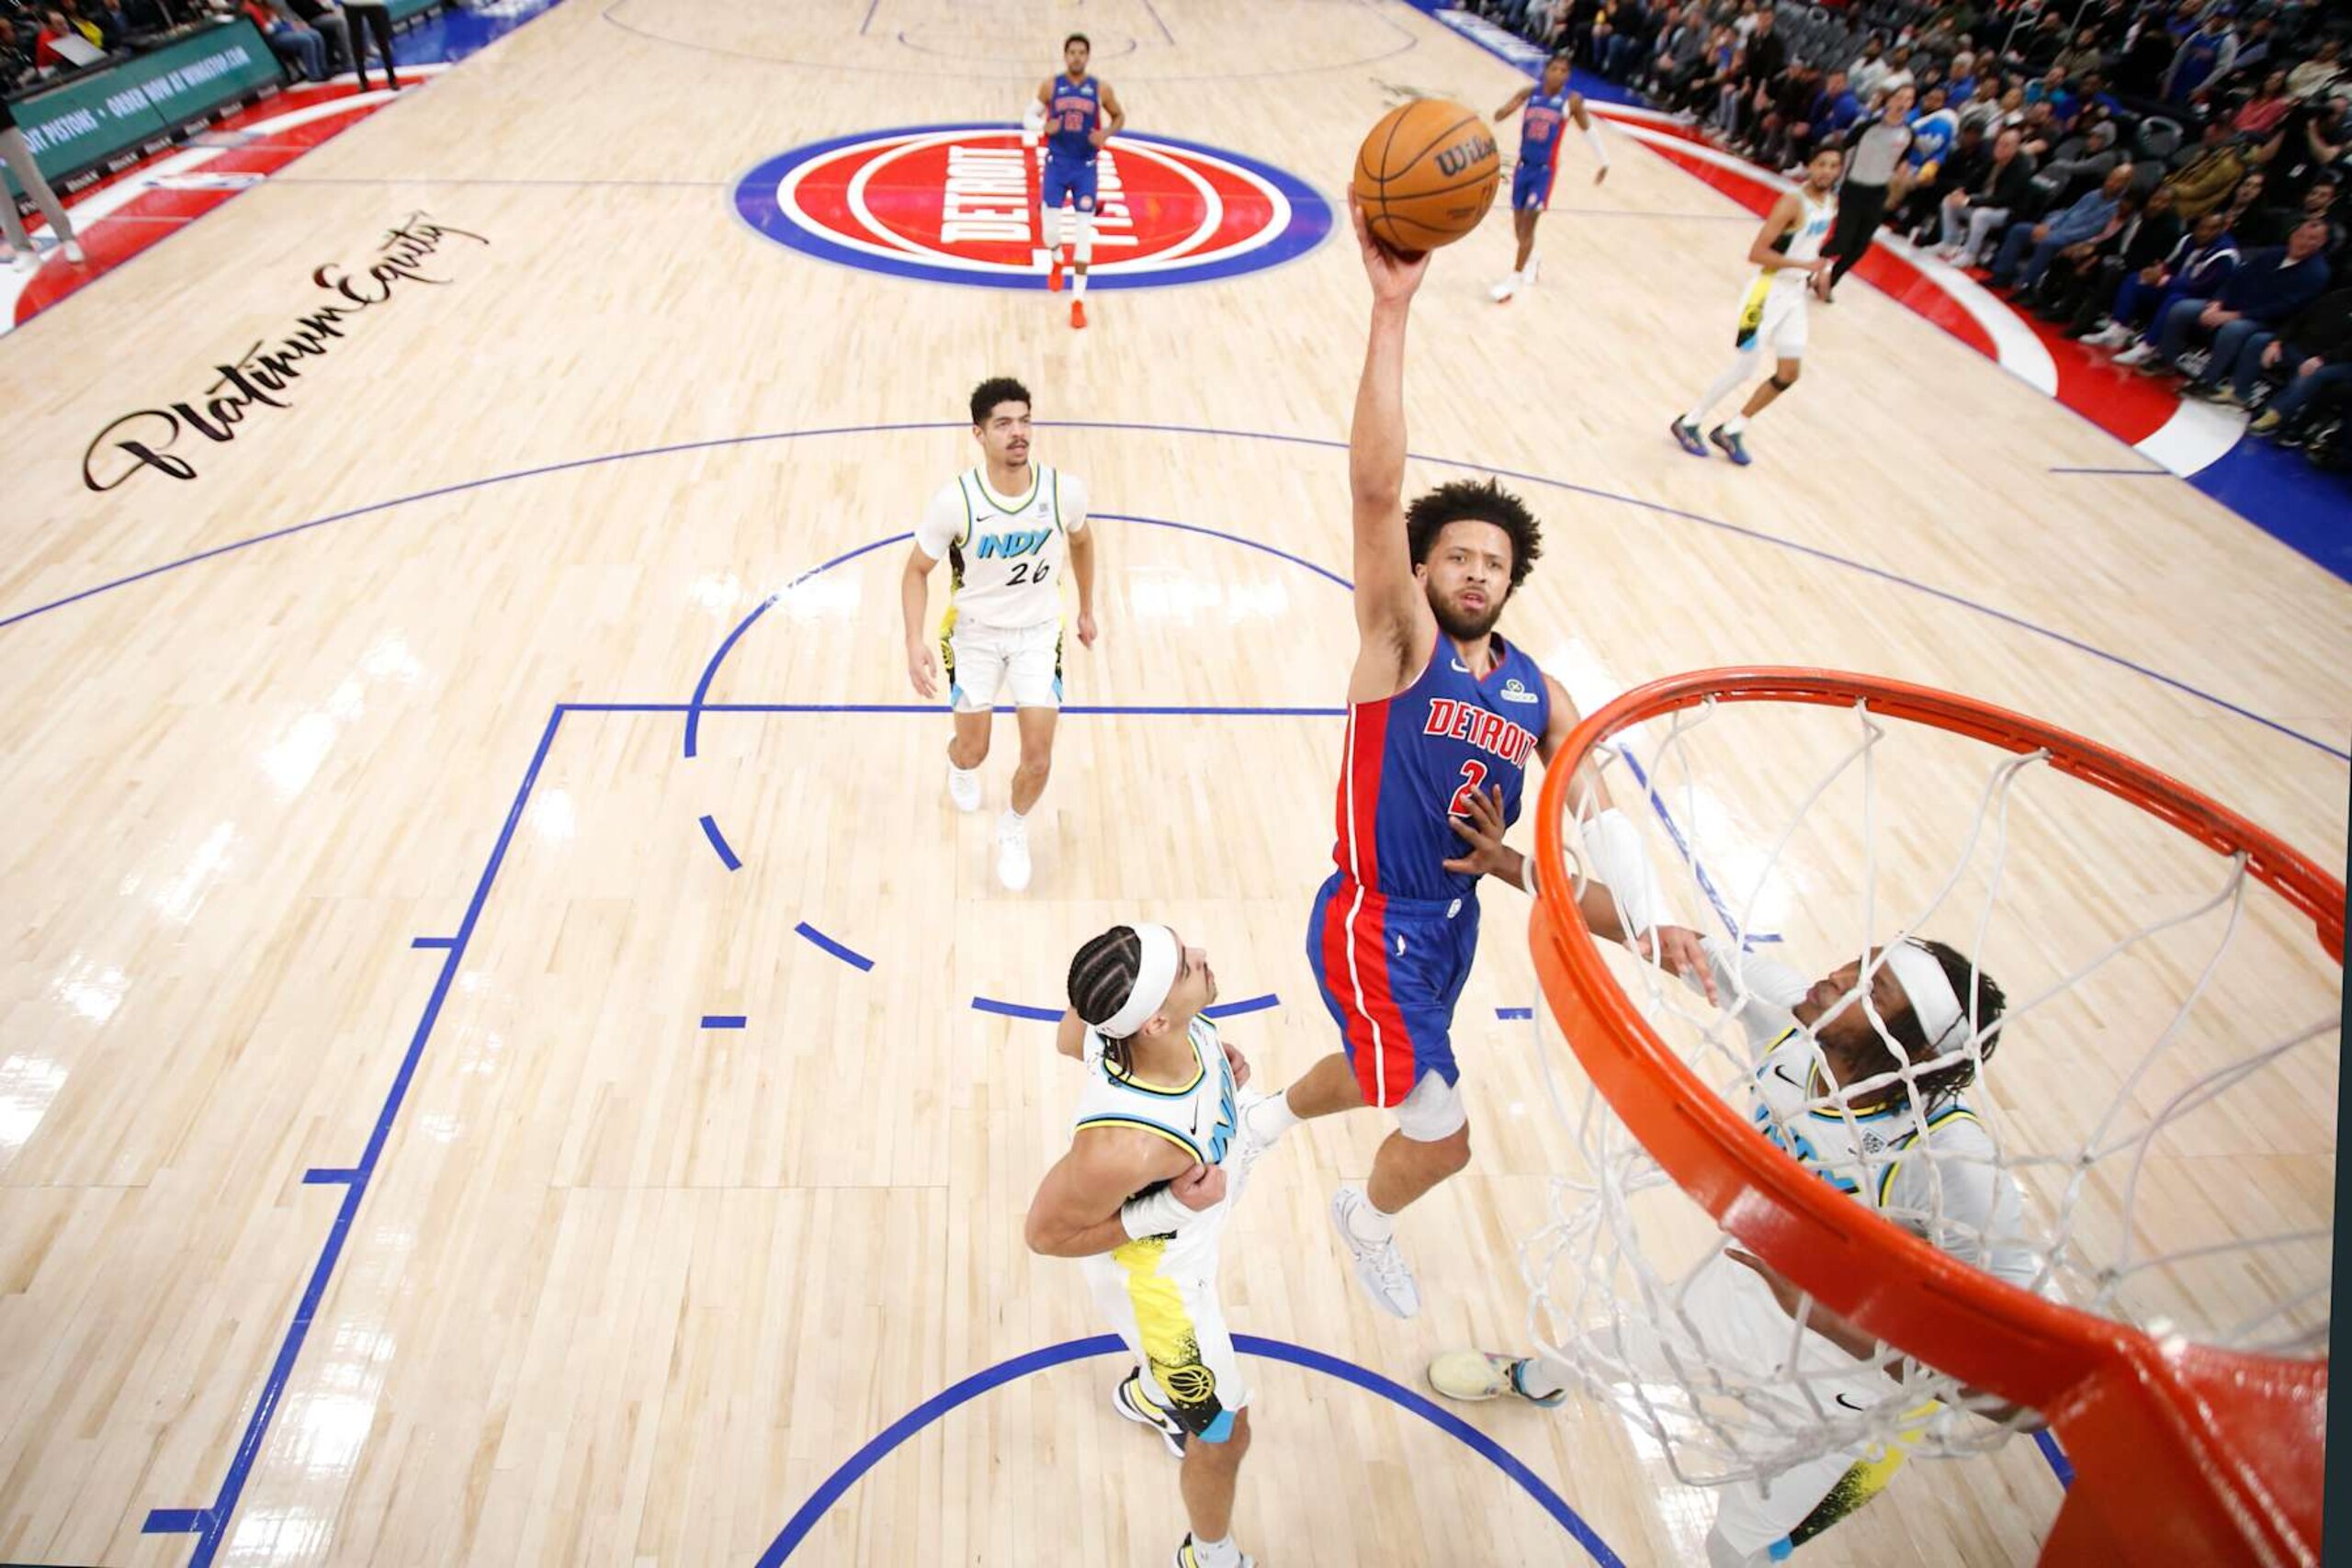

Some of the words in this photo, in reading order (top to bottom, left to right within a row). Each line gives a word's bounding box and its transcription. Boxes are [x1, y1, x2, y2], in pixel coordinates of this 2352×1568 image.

[40, 108, 98, 147] PISTONS
[106, 87, 150, 118] ORDER
[141, 76, 176, 103] NOW
[941, 145, 1031, 243] DETROIT
[85, 306, 345, 492] Platinum
[312, 210, 490, 306] Equity
[977, 527, 1053, 559] INDY
[1005, 558, 1050, 586] 26
[1423, 698, 1538, 771] DETROIT
[1448, 759, 1488, 818] 2
